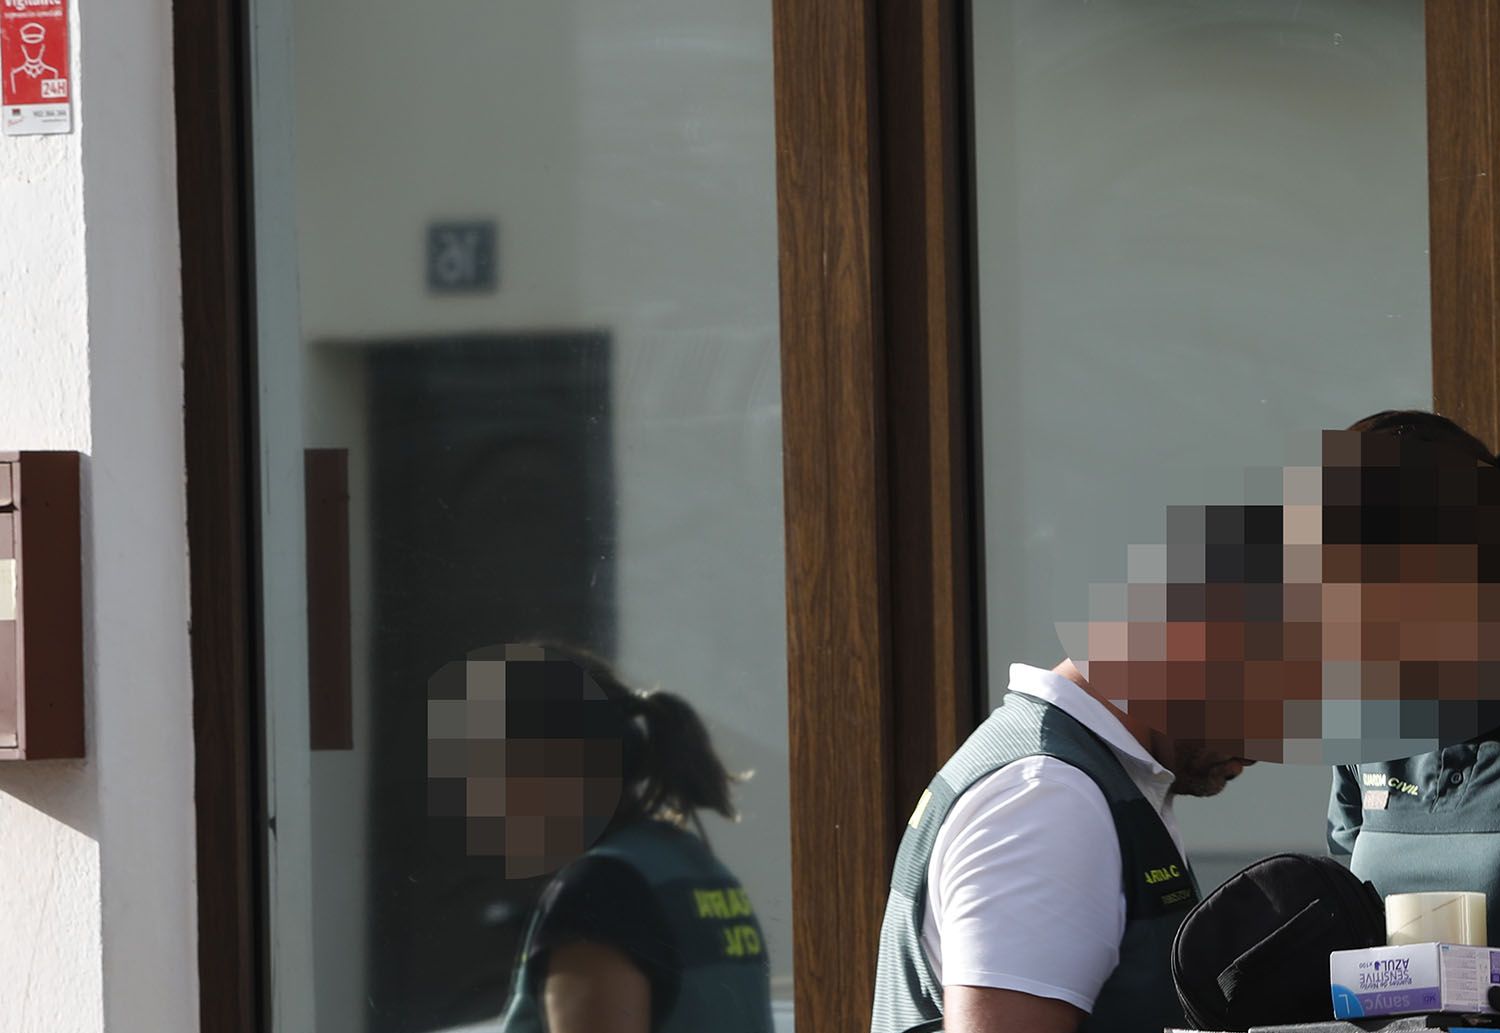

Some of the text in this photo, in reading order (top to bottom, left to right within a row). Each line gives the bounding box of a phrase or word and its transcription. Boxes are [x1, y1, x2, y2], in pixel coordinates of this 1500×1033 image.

[1387, 777, 1419, 796] CIVIL
[1381, 958, 1410, 971] AZUL
[1359, 969, 1409, 984] SENSITIVE
[1364, 994, 1410, 1011] sanyc
